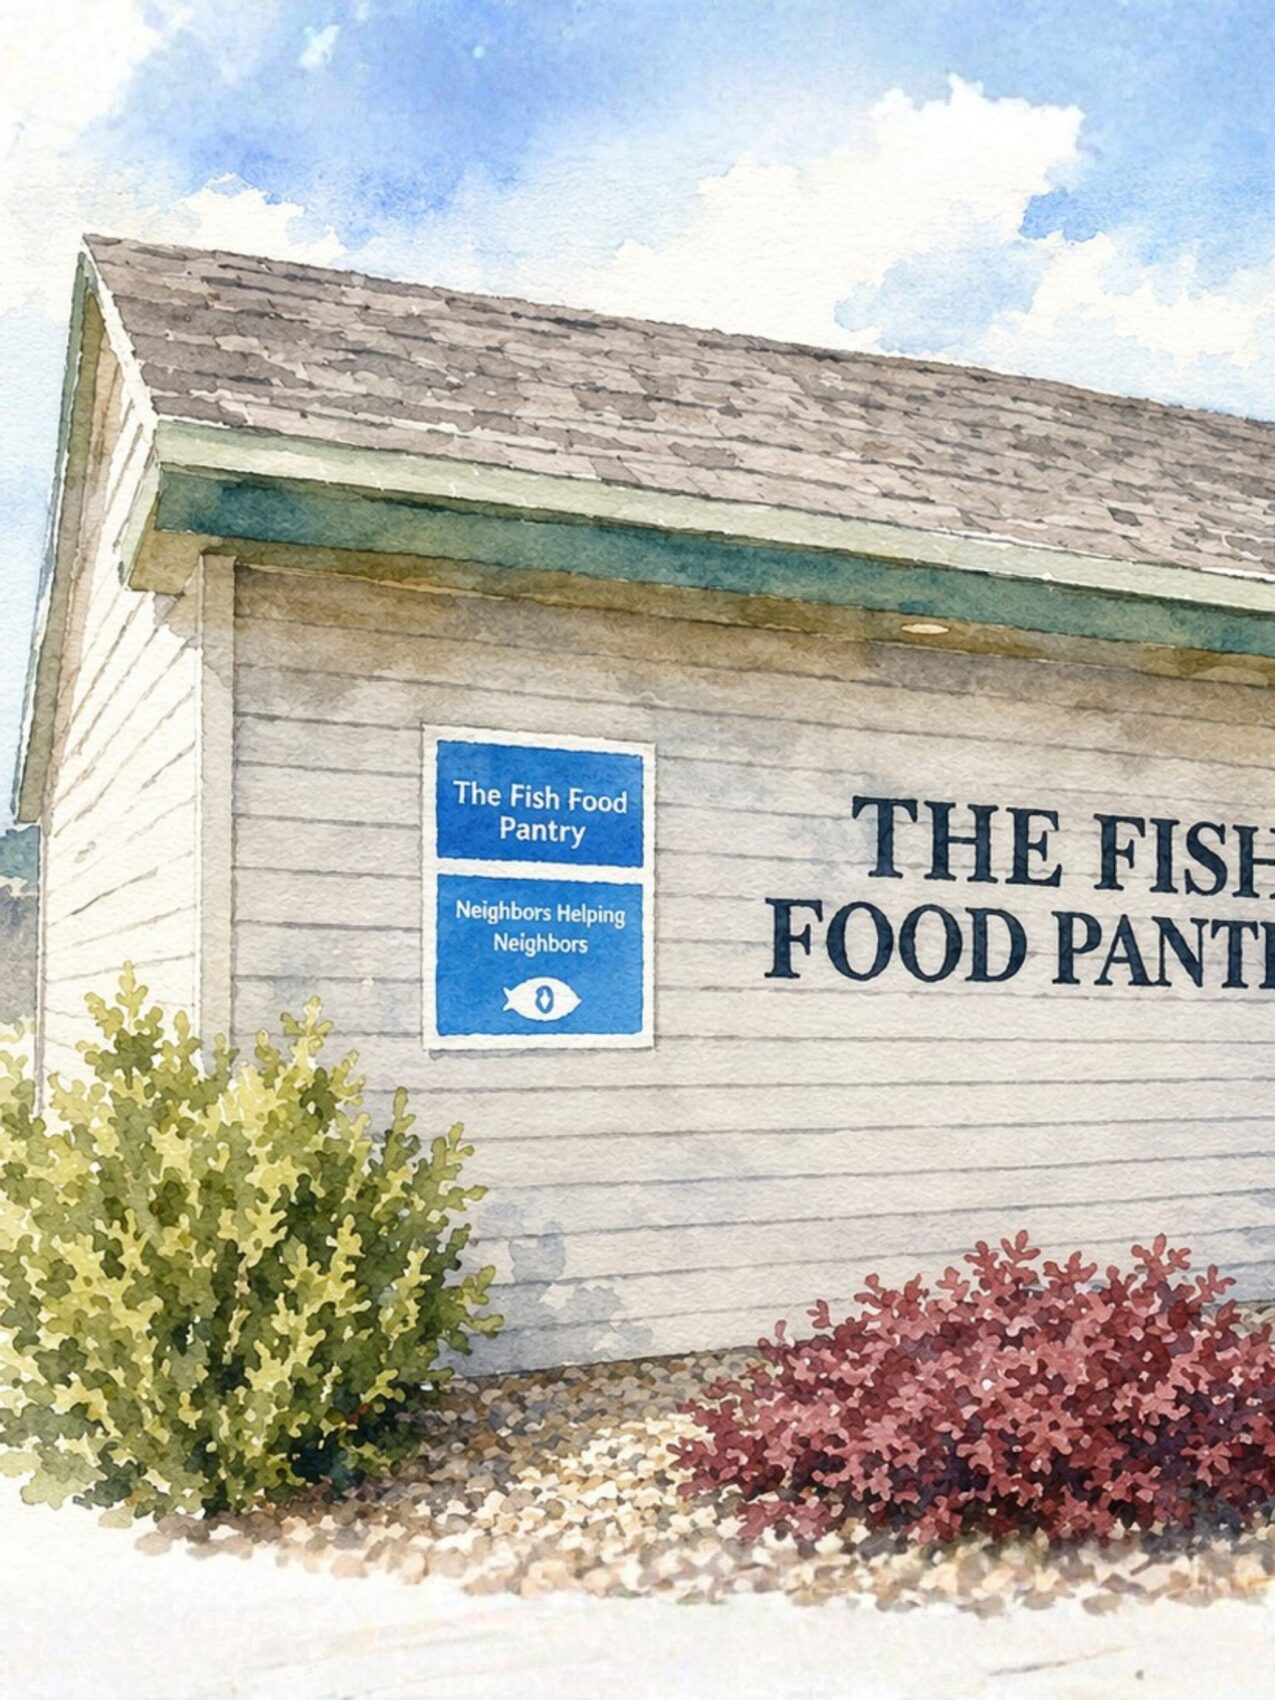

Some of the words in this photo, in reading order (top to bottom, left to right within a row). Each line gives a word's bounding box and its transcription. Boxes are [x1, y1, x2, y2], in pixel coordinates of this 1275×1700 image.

[453, 780, 501, 806] The
[510, 783, 560, 810] Fish
[568, 788, 628, 814] Food
[500, 816, 586, 849] Pantry
[852, 795, 1062, 888] THE
[455, 900, 552, 925] Neighbors
[556, 904, 626, 929] Helping
[493, 933, 589, 957] Neighbors
[764, 897, 1028, 982] FOOD
